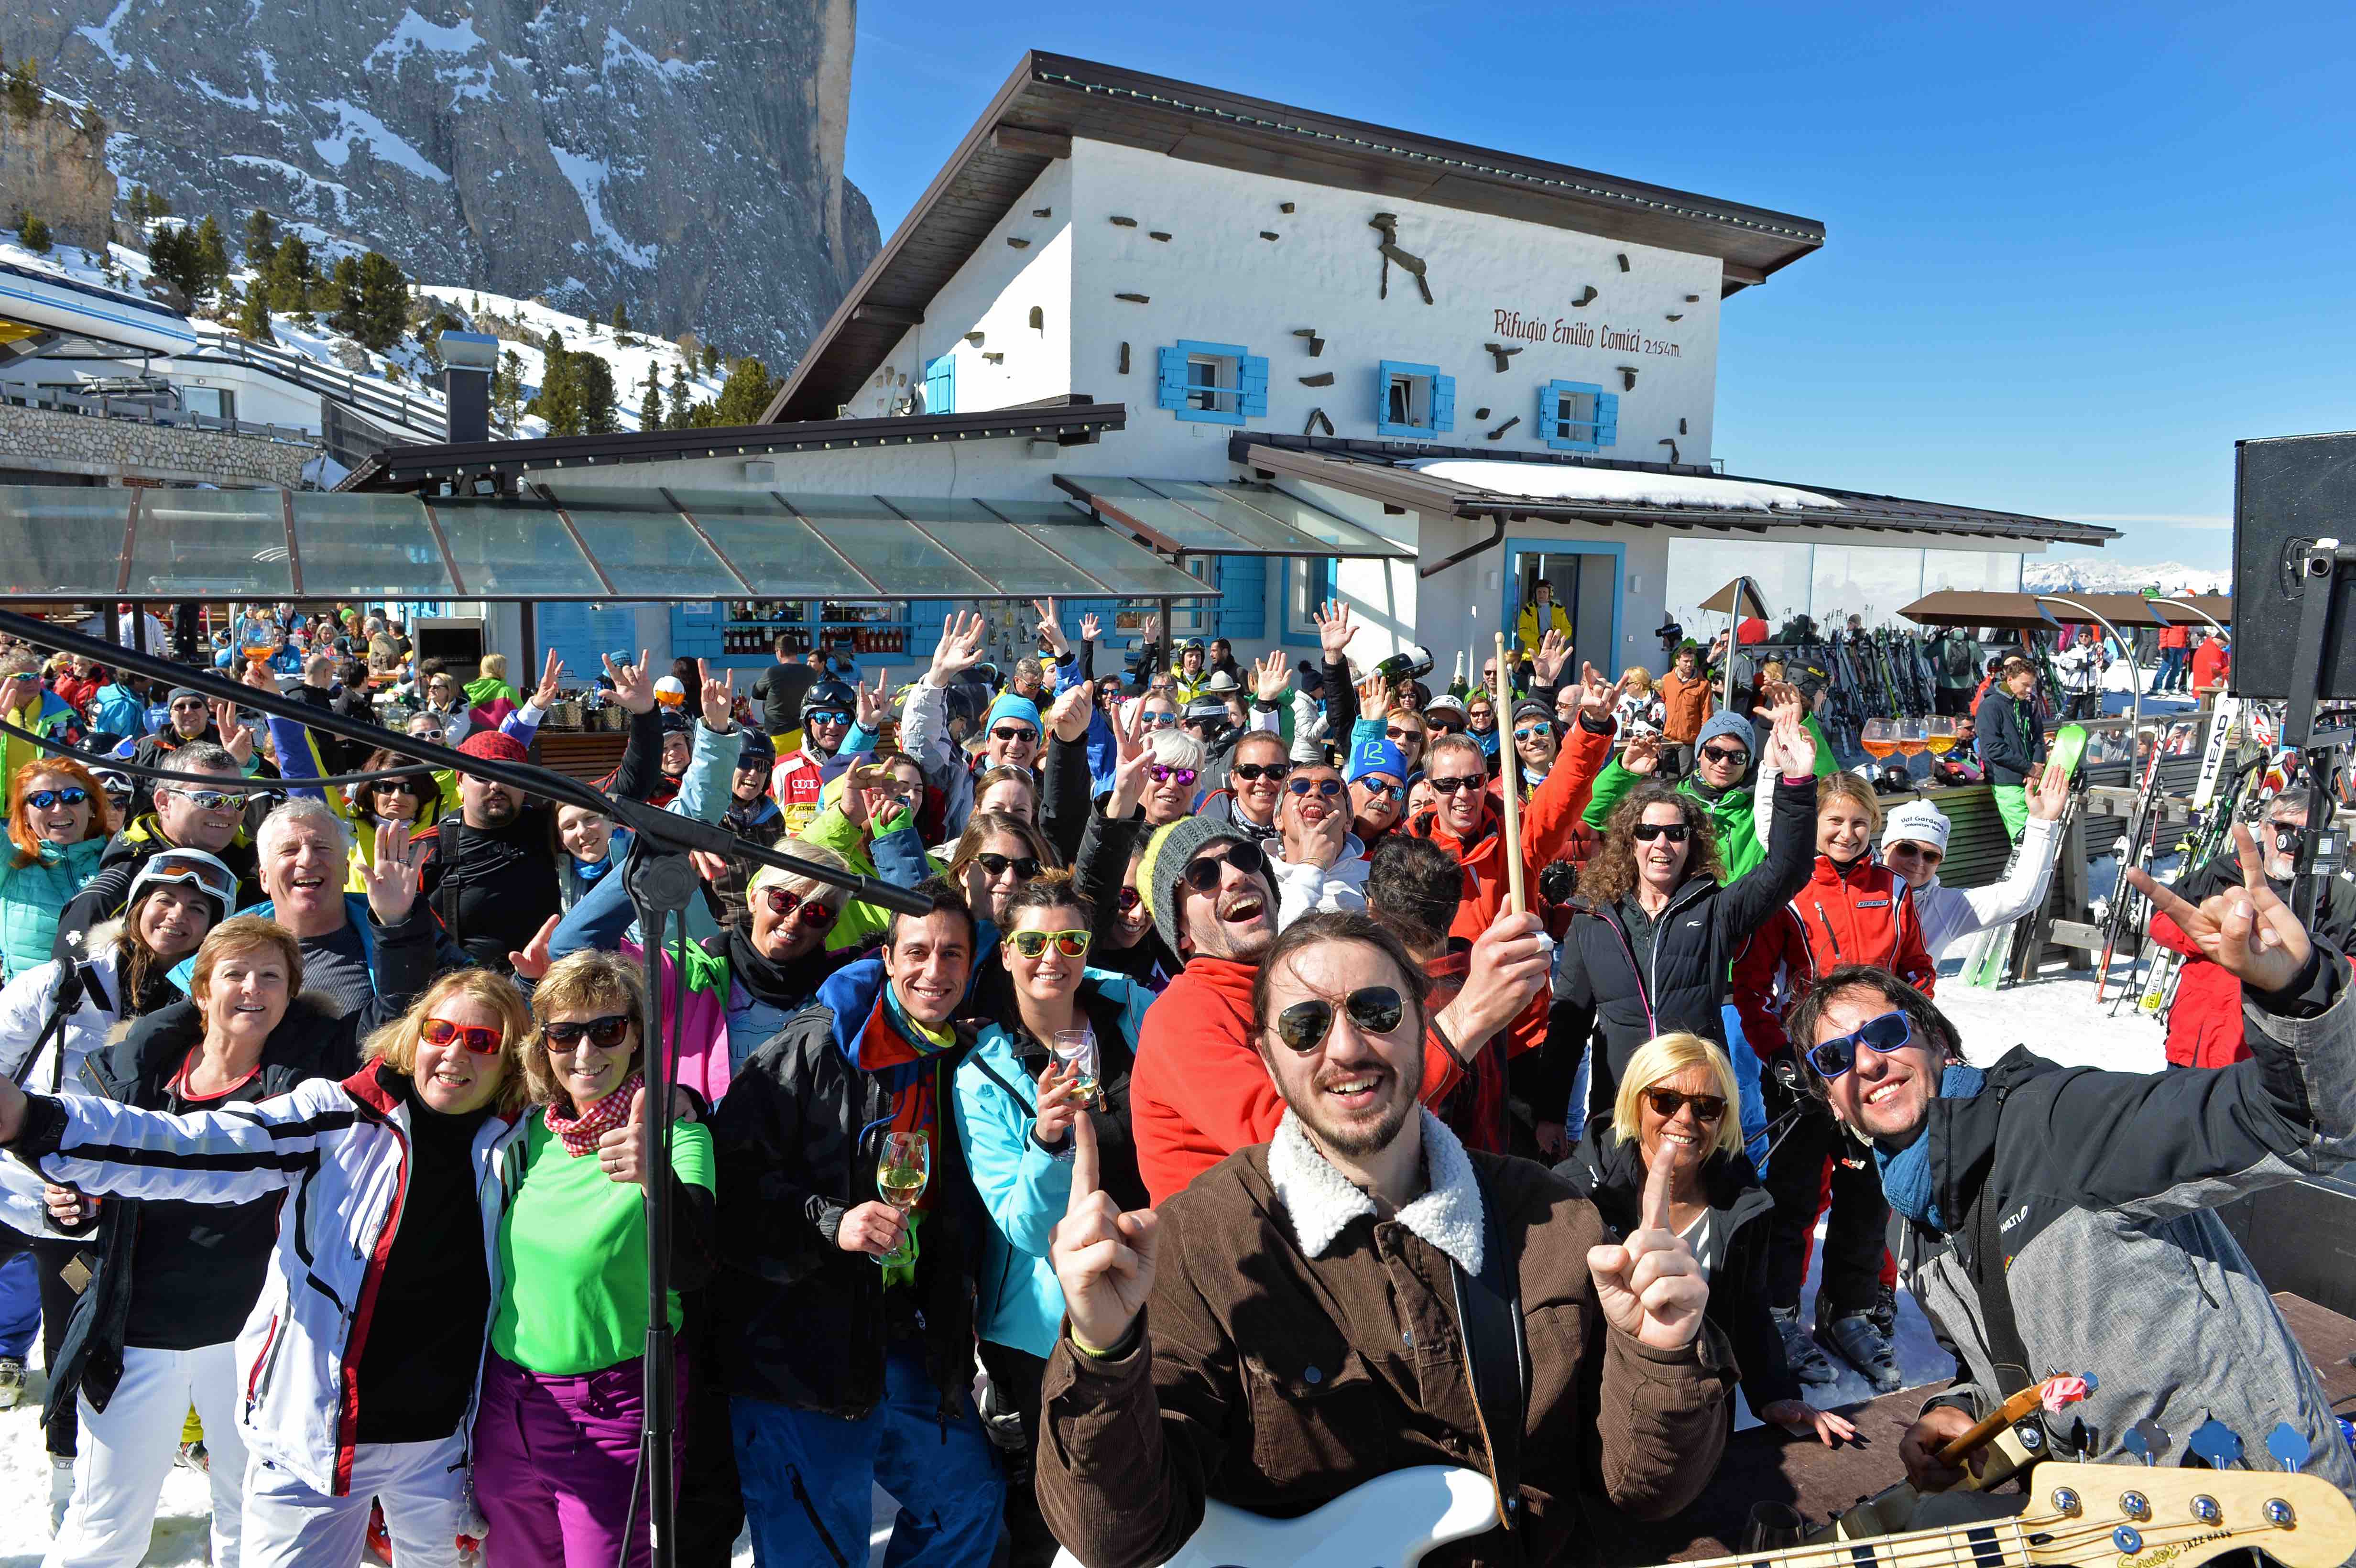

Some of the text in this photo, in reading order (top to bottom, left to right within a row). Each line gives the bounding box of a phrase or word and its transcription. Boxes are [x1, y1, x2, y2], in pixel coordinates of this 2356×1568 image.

[1494, 309, 1547, 345] Rifugio
[1552, 318, 1594, 348] Emilio
[1601, 324, 1640, 352] Comici
[2203, 715, 2228, 780] HEAD
[2149, 969, 2161, 1008] REBELS
[2000, 1213, 2021, 1233] HALTI
[2183, 1535, 2205, 1552] JAZZ
